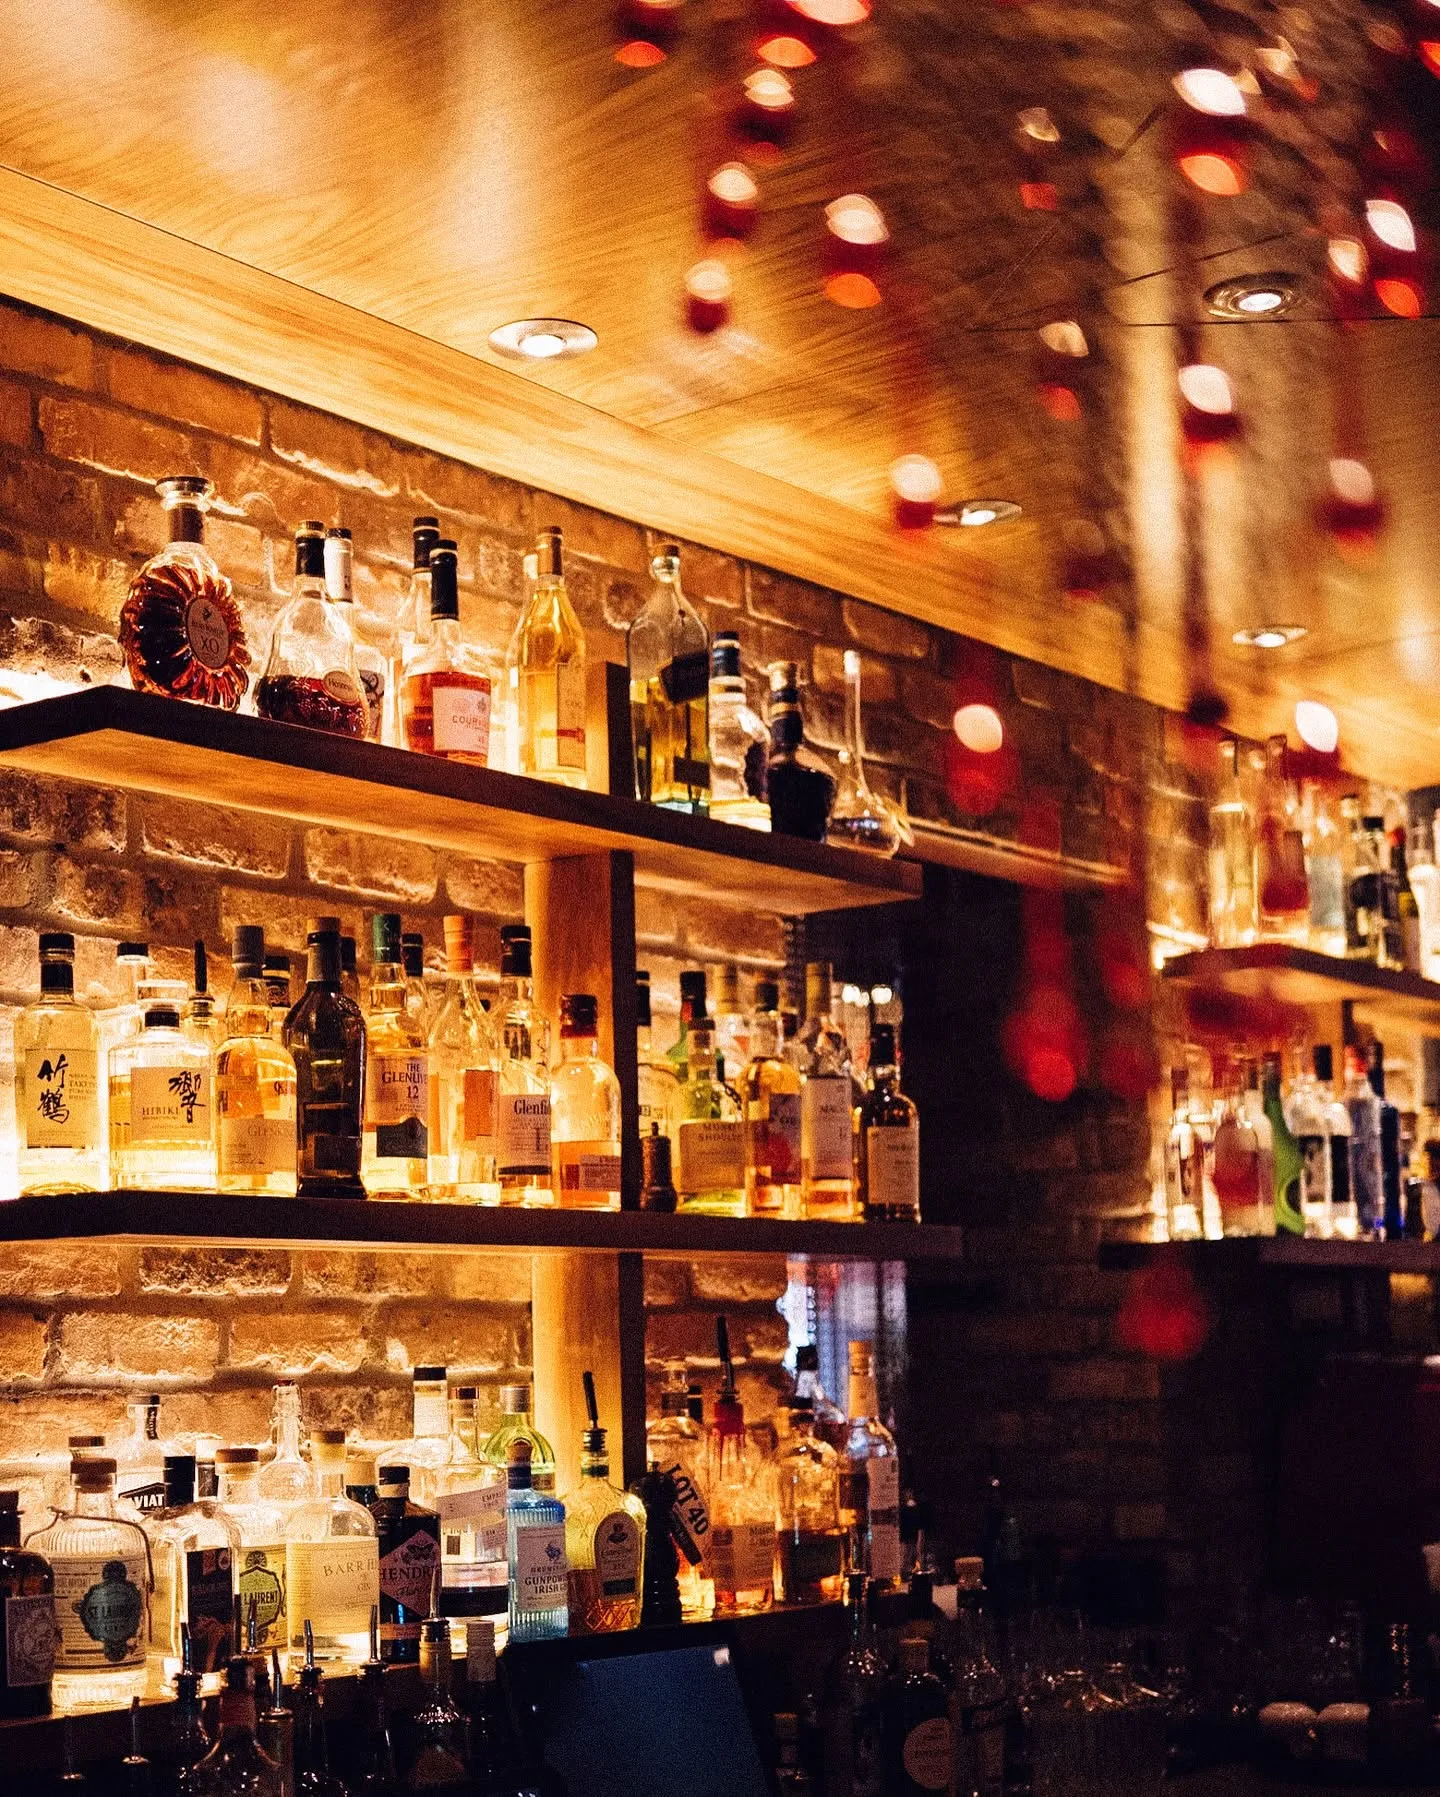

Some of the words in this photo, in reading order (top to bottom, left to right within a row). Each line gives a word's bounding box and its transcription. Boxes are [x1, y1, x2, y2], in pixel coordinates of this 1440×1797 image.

[452, 715, 488, 727] COUR
[406, 1063, 420, 1073] THE
[37, 1053, 70, 1124] 竹鶴
[407, 1085, 419, 1099] 12
[168, 1070, 207, 1124] 響
[142, 1107, 178, 1116] HIBIKI
[513, 1099, 550, 1115] Glenfi
[131, 1493, 165, 1508] VIAT
[663, 1463, 699, 1505] LOT
[687, 1507, 709, 1536] 40
[323, 1559, 363, 1577] BARR
[534, 1583, 559, 1595] IRISH
